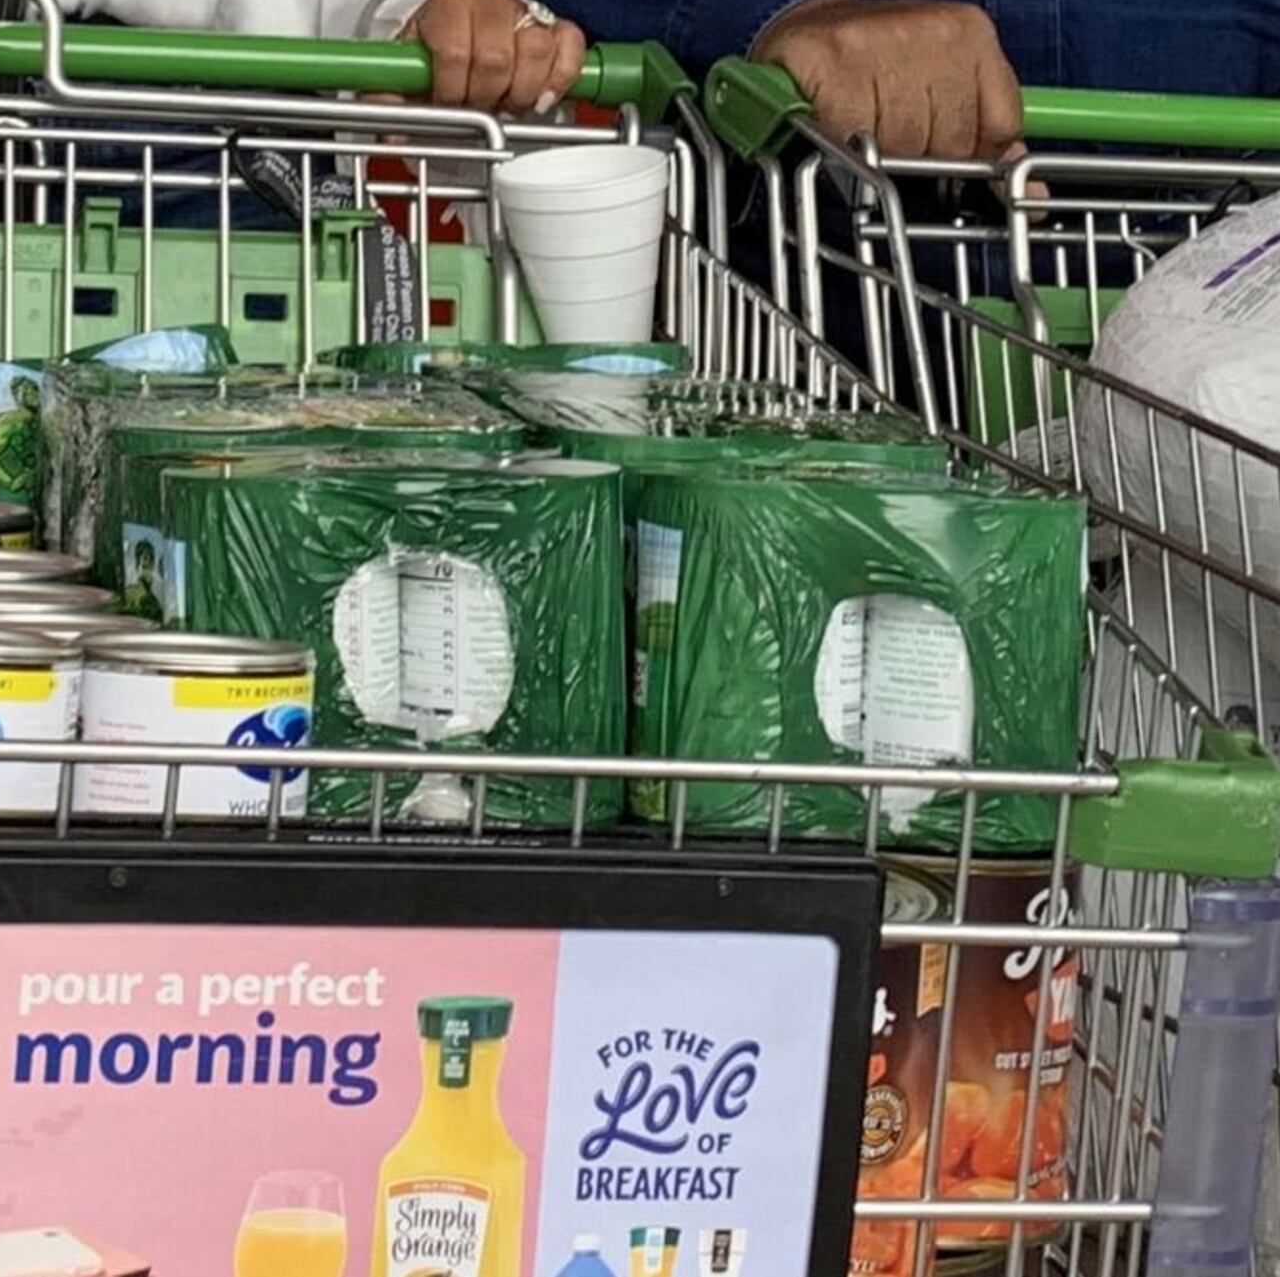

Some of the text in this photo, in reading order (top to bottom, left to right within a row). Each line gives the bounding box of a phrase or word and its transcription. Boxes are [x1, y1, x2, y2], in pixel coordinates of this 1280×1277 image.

[228, 799, 271, 817] WHO
[18, 962, 386, 1016] pour a perfect
[14, 1010, 382, 1107] morning
[597, 1028, 716, 1069] FOR THE
[696, 1132, 733, 1155] OF
[576, 1166, 742, 1202] BREAKFAST
[395, 1197, 477, 1237] Simply
[391, 1232, 477, 1267] Orange
